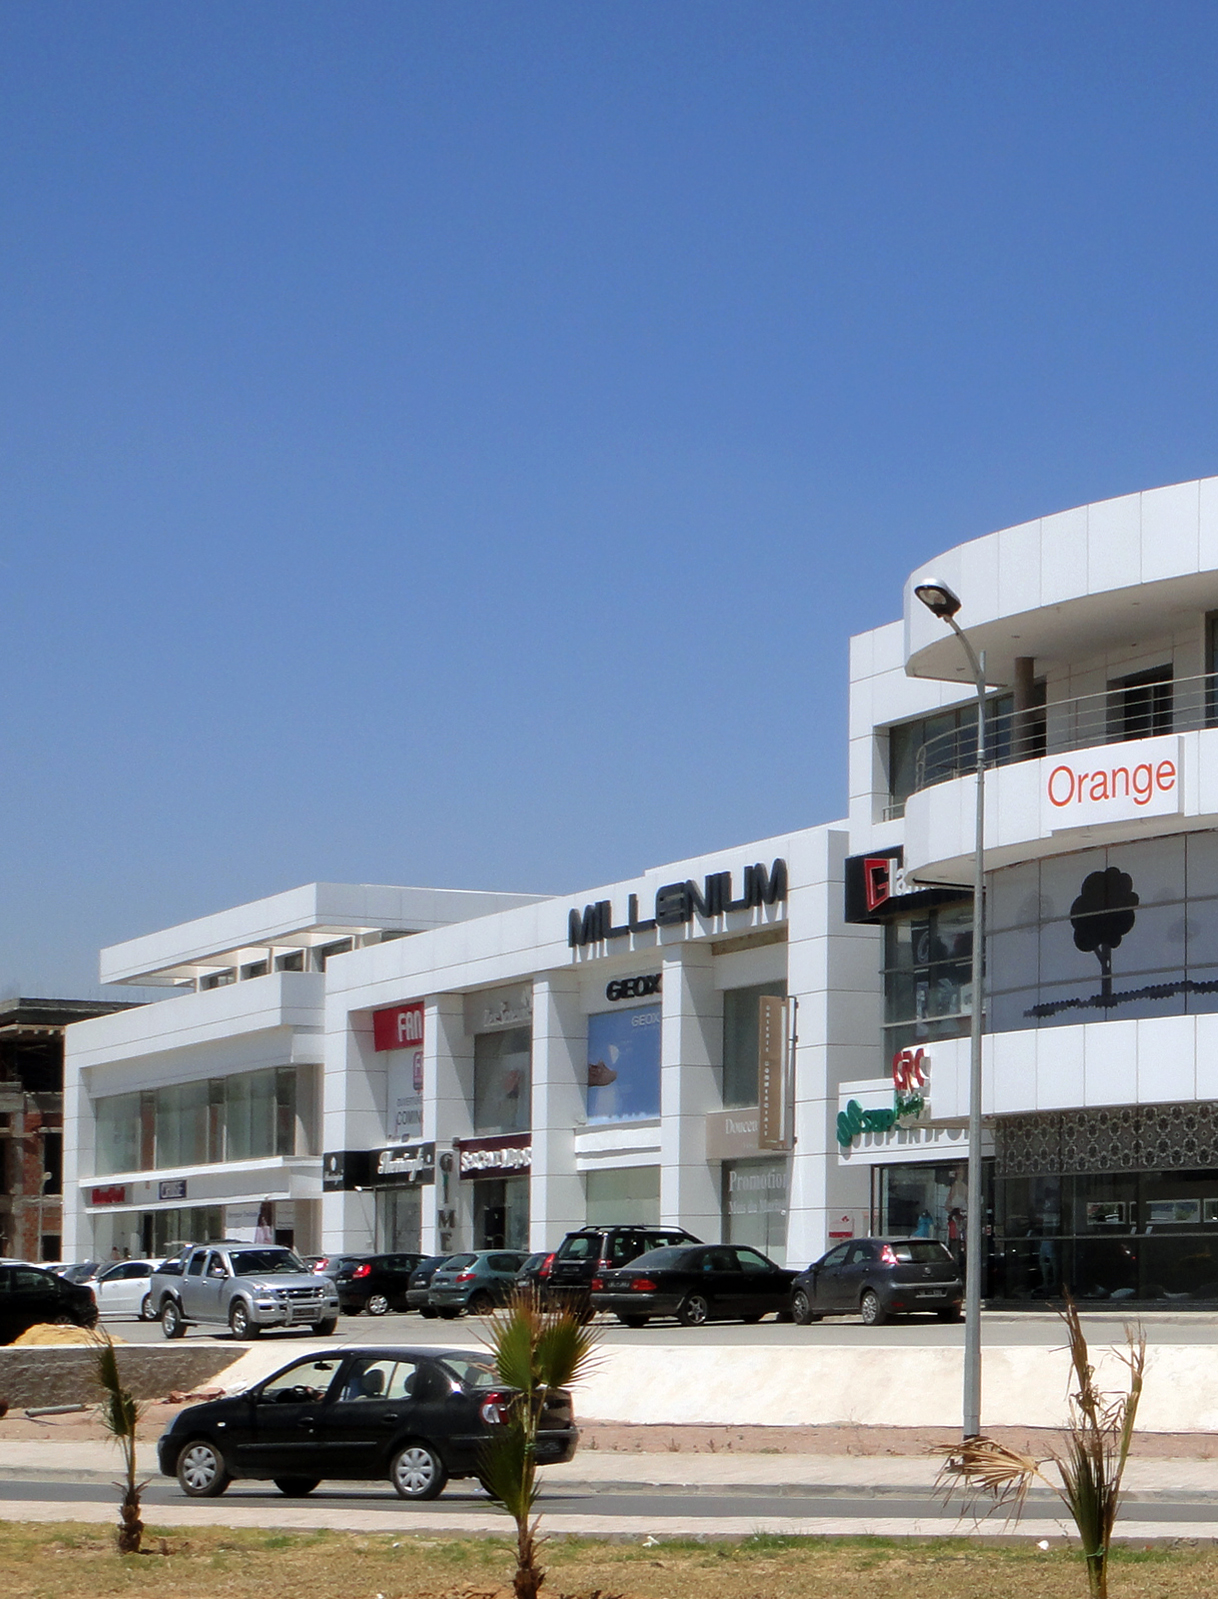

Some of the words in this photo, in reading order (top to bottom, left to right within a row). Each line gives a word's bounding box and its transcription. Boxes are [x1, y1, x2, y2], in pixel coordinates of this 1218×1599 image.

[1048, 758, 1176, 807] Orange
[568, 858, 788, 948] MILLENIUM
[606, 973, 662, 1001] GEOX
[631, 1012, 661, 1028] GEOX
